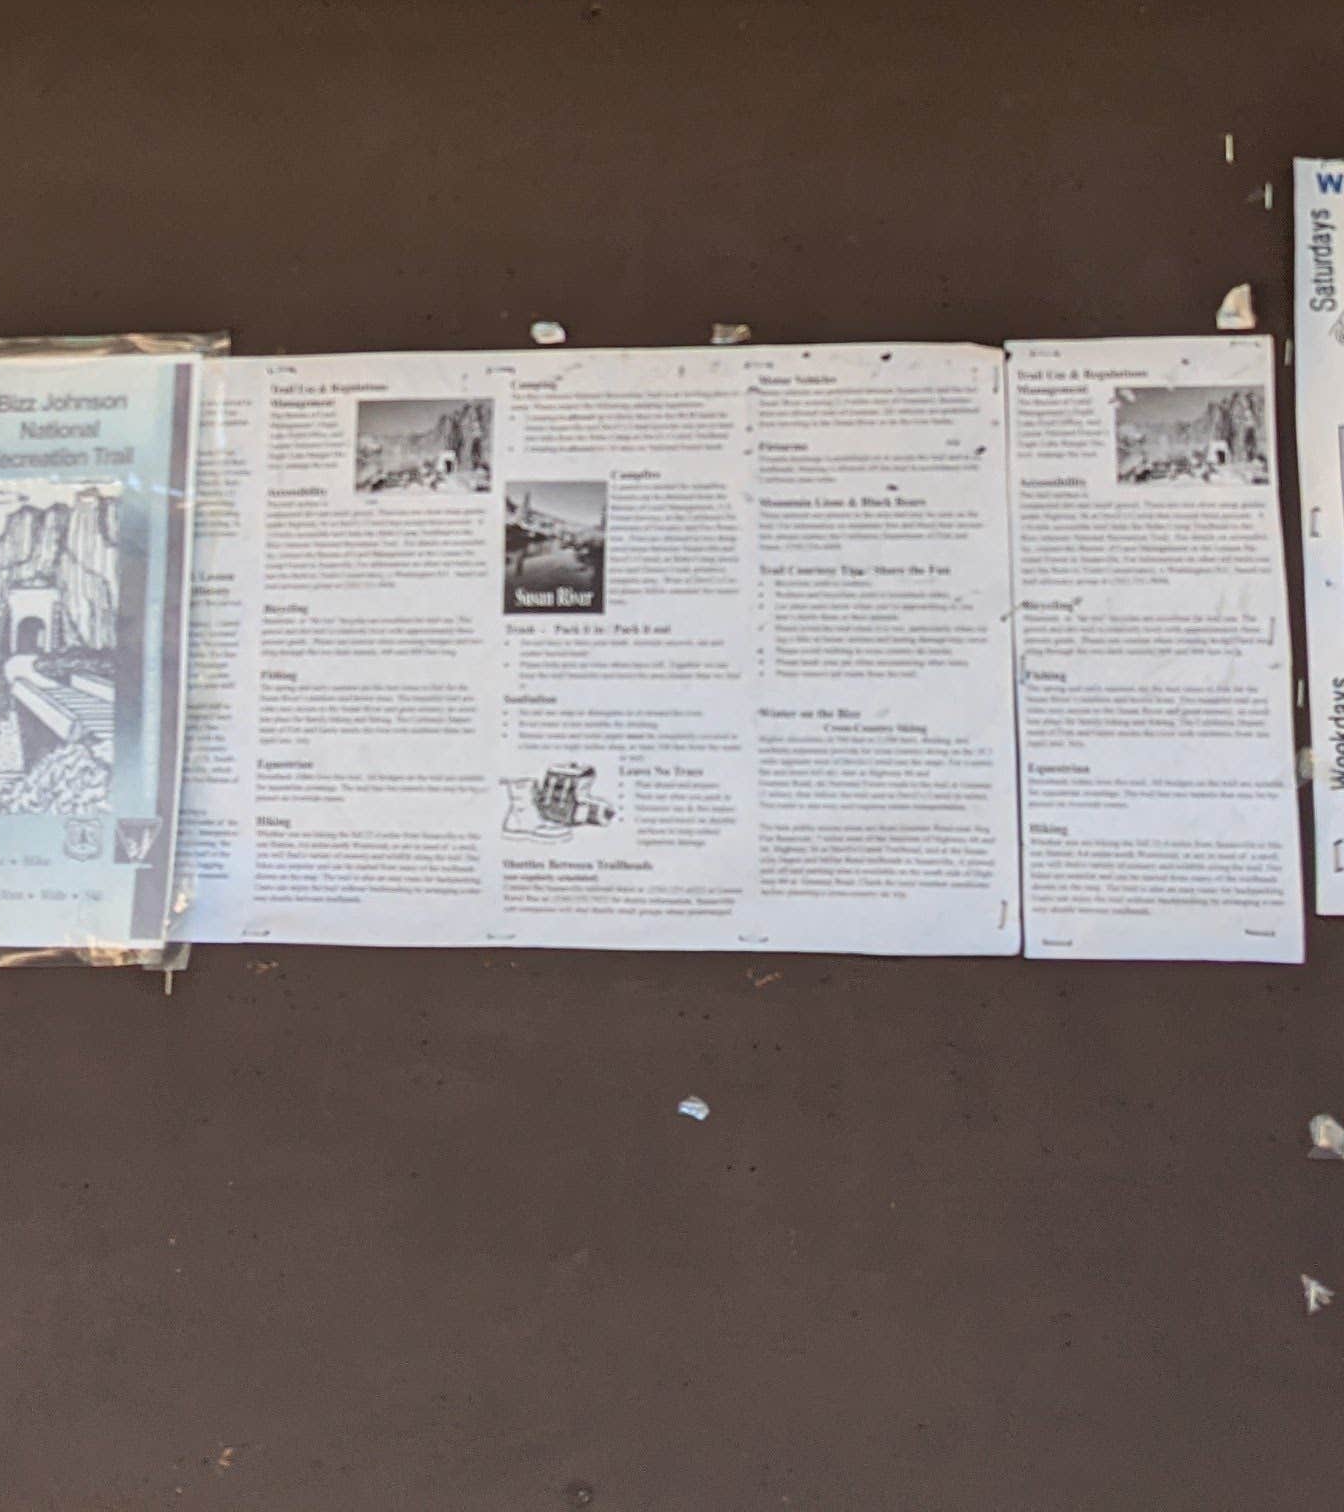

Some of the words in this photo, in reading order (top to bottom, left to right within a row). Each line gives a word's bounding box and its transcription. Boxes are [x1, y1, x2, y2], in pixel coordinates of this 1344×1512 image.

[1309, 208, 1336, 313] Saturdays
[42, 394, 128, 411] Johnson
[21, 421, 99, 439] National
[94, 447, 134, 464] Trail
